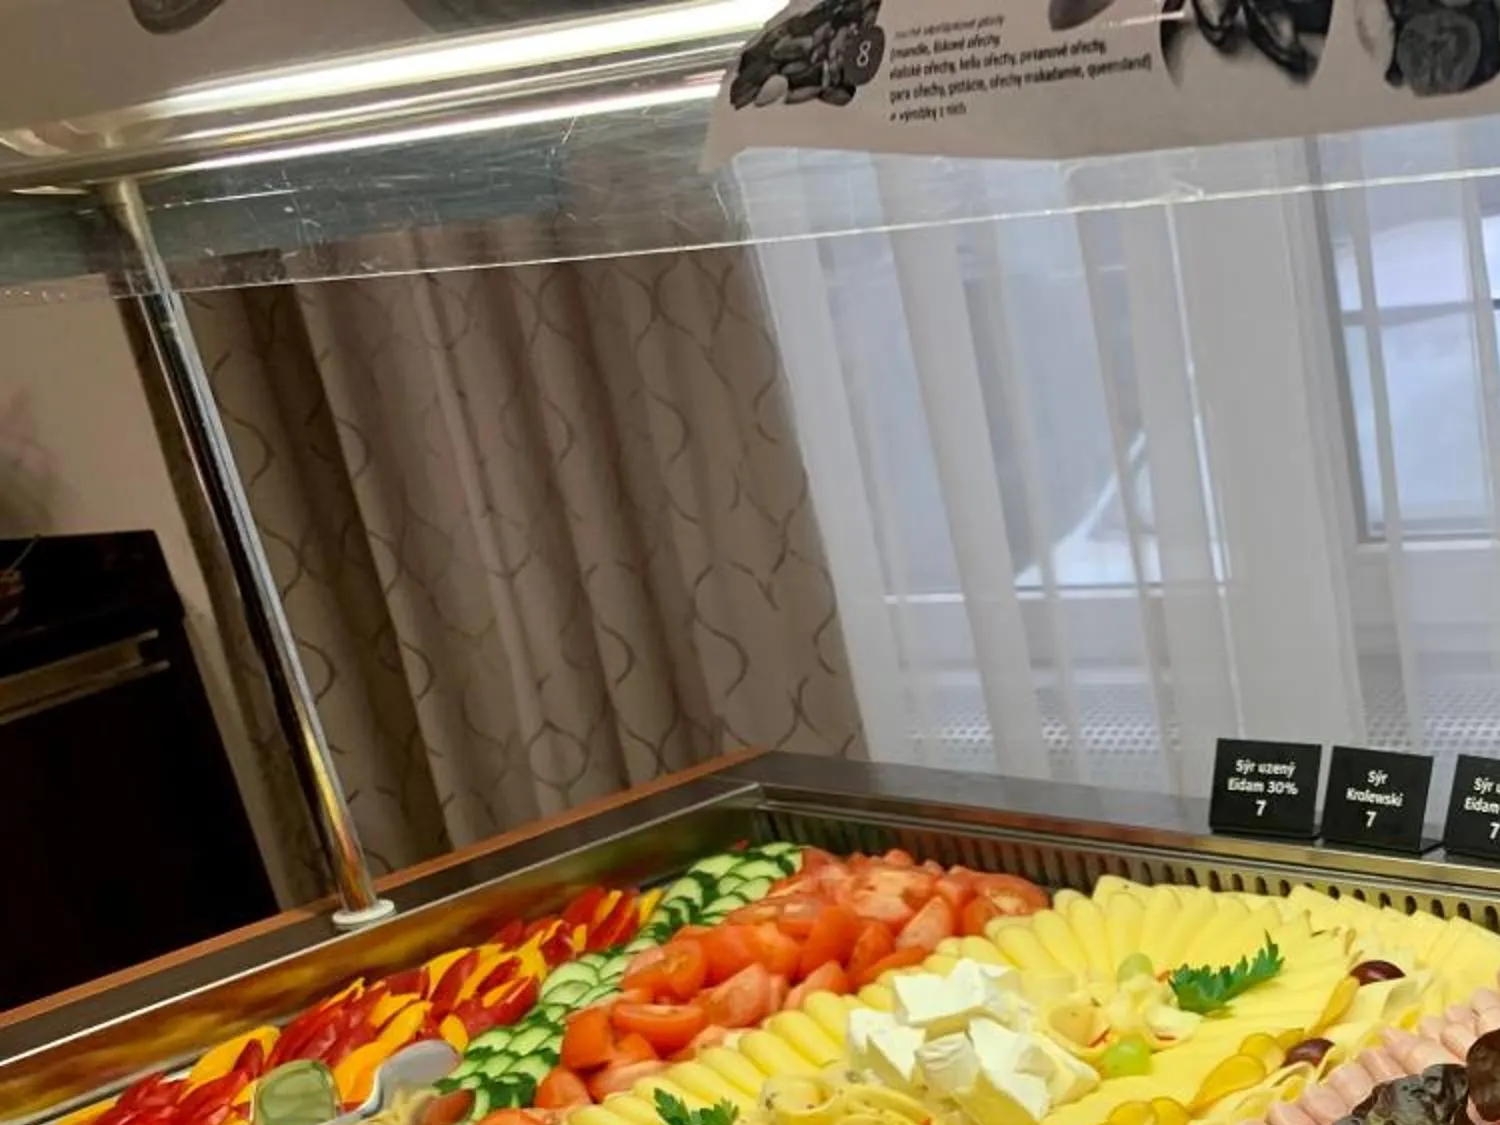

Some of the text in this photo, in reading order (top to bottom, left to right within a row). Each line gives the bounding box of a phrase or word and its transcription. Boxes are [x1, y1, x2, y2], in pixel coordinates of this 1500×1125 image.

[857, 40, 871, 67] 8
[1235, 758, 1296, 778] Sýr uzený
[1367, 768, 1389, 786] Sýr
[1227, 779, 1298, 796] Eidam 30%
[1473, 776, 1495, 794] Sýr
[1345, 787, 1404, 808] Krolewski
[1464, 796, 1500, 814] Eidam
[1255, 800, 1268, 817] 7
[1366, 811, 1377, 828] 7
[1488, 822, 1500, 840] 7
